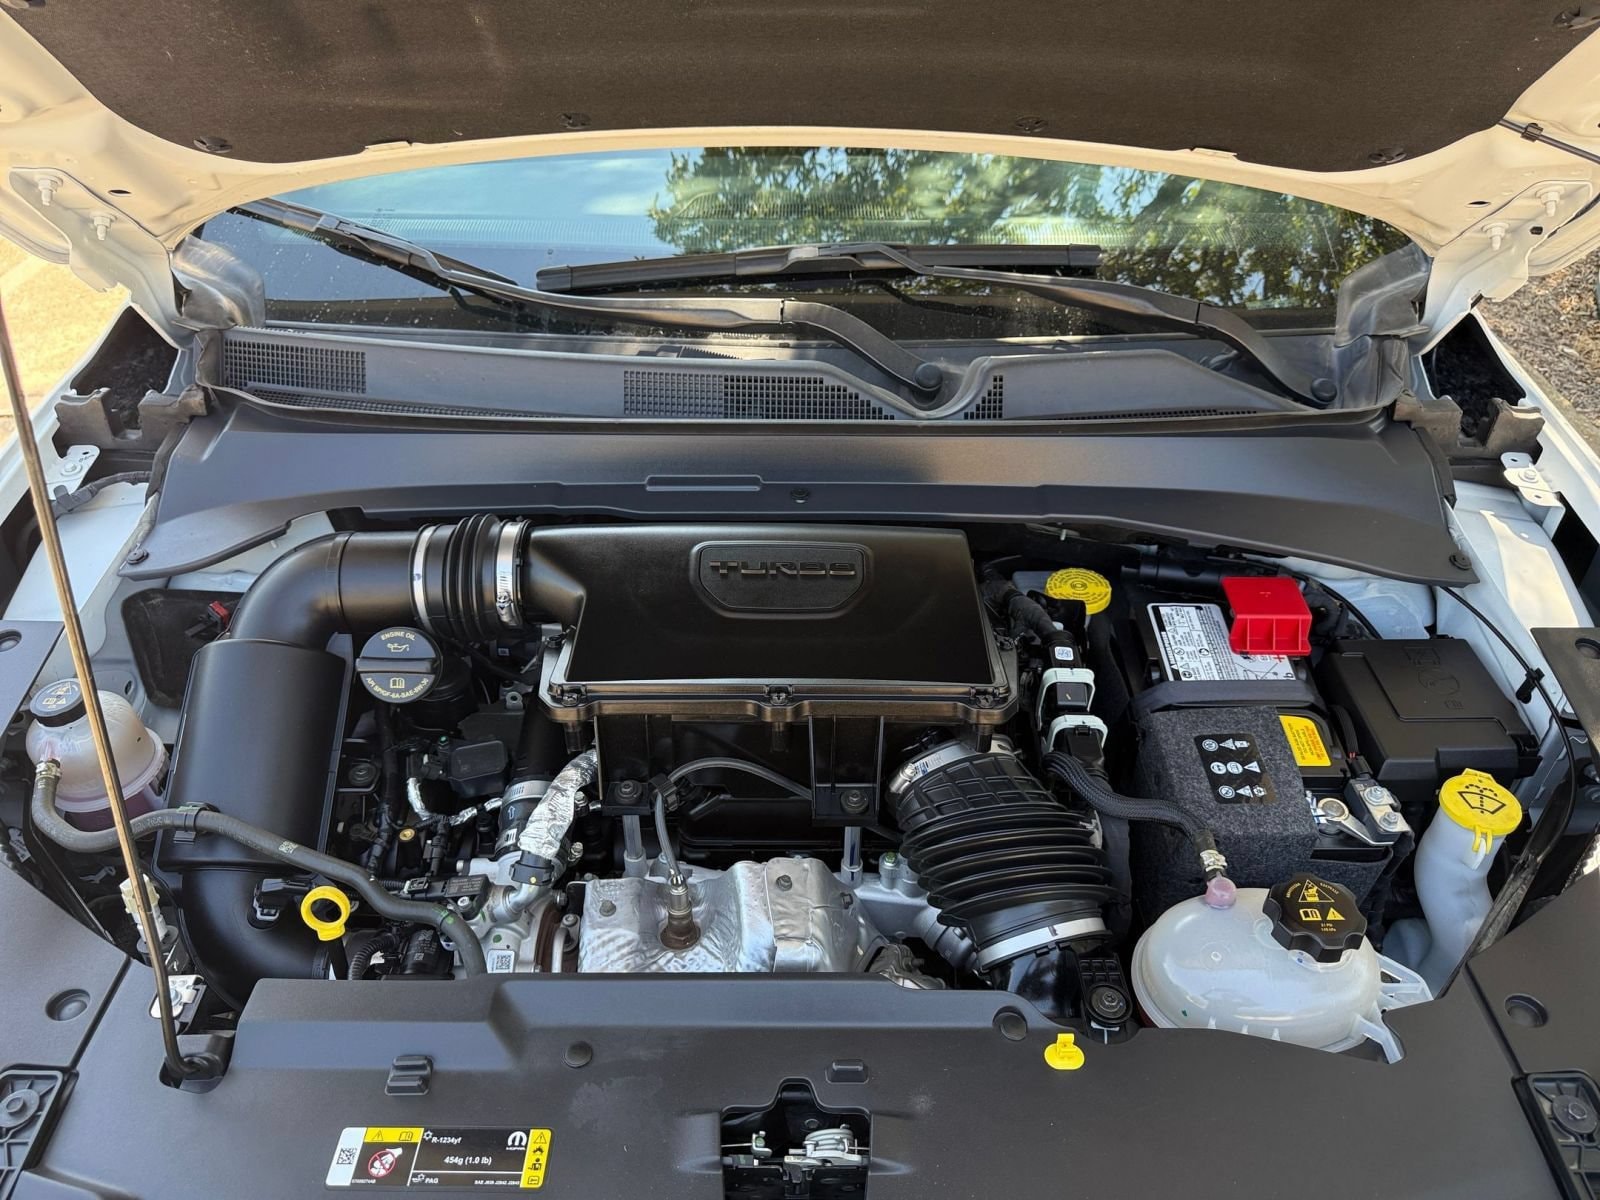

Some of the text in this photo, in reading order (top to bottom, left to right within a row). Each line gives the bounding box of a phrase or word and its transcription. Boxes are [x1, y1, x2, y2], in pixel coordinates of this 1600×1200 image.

[709, 561, 856, 577] TURBO
[380, 631, 416, 640] ENGINE OIL
[431, 1136, 462, 1144] R-1234yf
[443, 1156, 492, 1165] 454g (1.0 lb)
